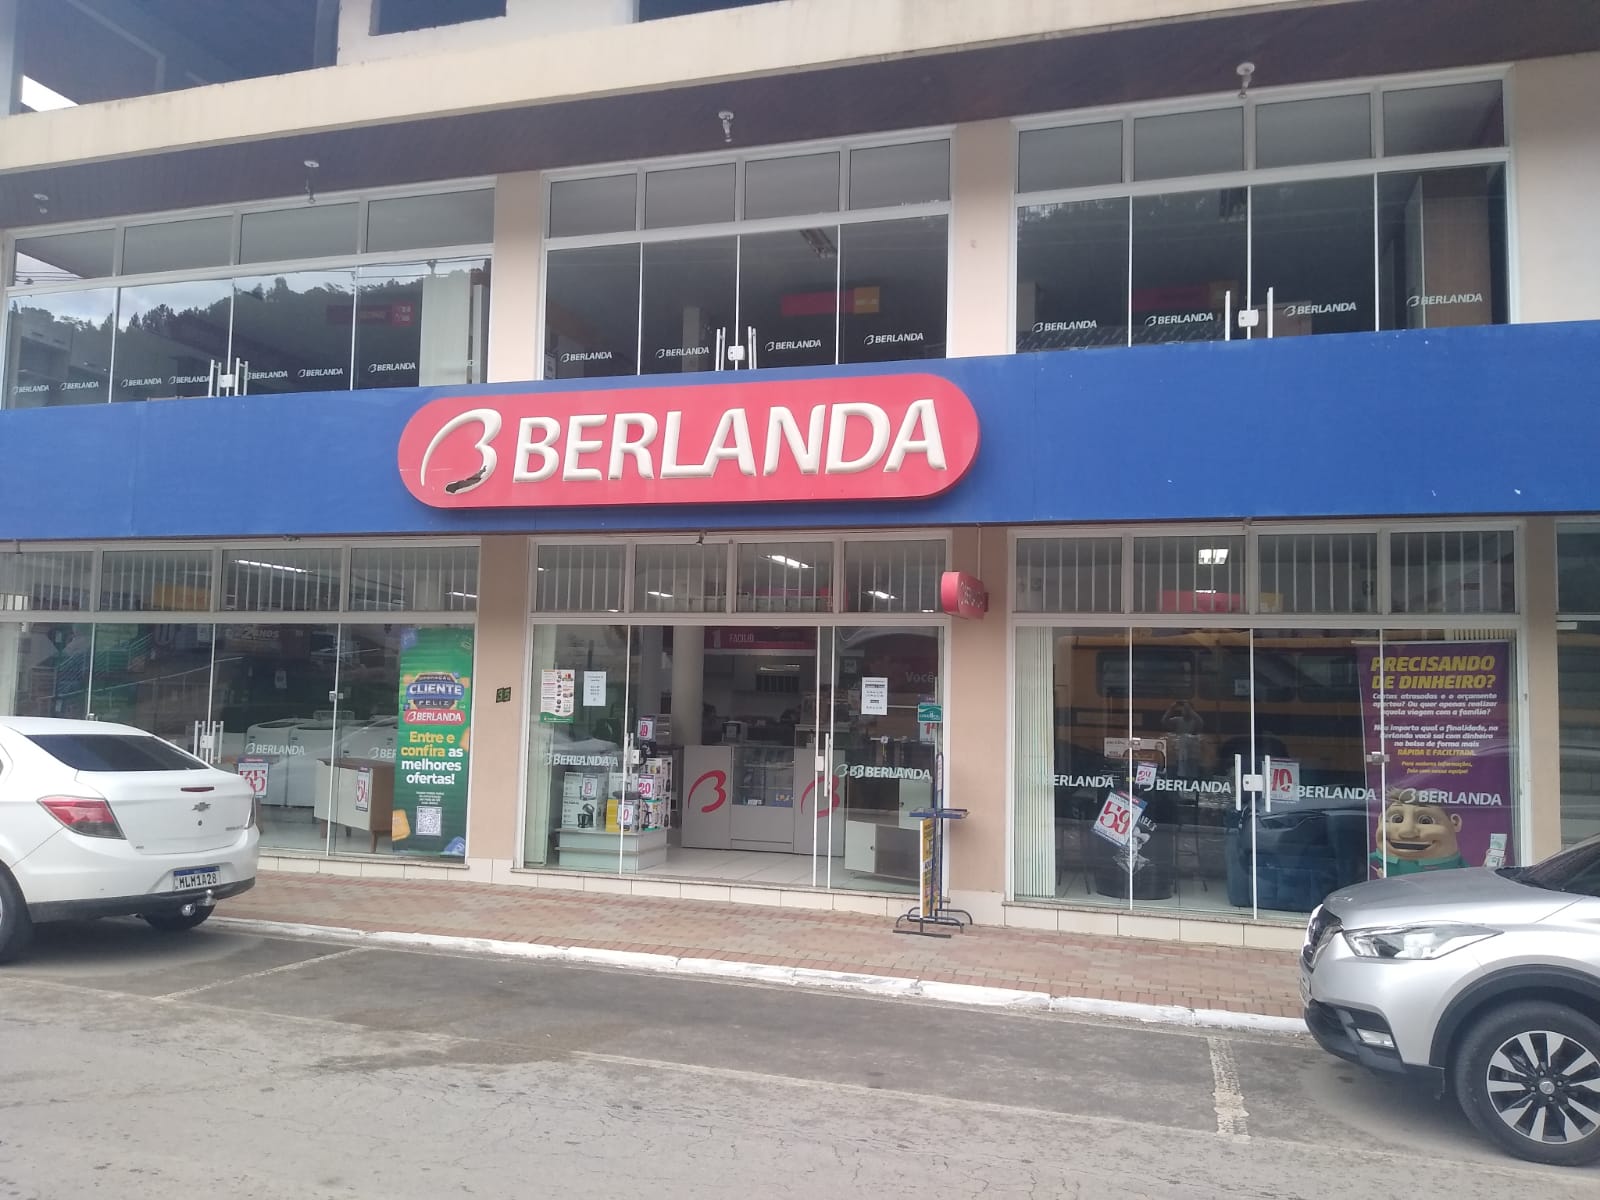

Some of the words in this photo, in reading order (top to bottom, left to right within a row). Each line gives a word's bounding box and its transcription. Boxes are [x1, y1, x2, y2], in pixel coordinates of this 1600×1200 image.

[1421, 293, 1483, 306] BERLANDA
[1297, 302, 1357, 315] BERLANDA
[1158, 312, 1214, 325] BERLANDA
[1044, 320, 1098, 332] BERLANDA
[875, 332, 924, 344] BERLANDA
[774, 339, 822, 351] BERLANDA
[569, 351, 613, 361] BERLANDA
[665, 346, 710, 358] BERLANDA
[305, 368, 344, 377] BERLANDA
[377, 362, 416, 372] BERLANDA
[251, 370, 288, 380] BERLANDA
[66, 381, 99, 390] BERLANDA
[127, 377, 162, 387] BERLANDA
[18, 384, 50, 393] BERLANDA
[512, 399, 948, 483] BERLANDA
[1370, 655, 1496, 672] PRECISANDO
[1371, 675, 1394, 689] DE
[1398, 674, 1497, 689] DINHEIRO?
[409, 683, 462, 695] CLIENTE
[1400, 692, 1438, 700] atrasadas
[1456, 693, 1498, 701] orçamento
[416, 712, 462, 722] BERLANDA
[1407, 708, 1434, 717] viagem
[1390, 724, 1419, 732] importa
[1420, 724, 1438, 732] qual
[409, 731, 444, 743] Entre
[446, 734, 455, 743] e
[256, 744, 305, 755] BERLANDA
[1436, 740, 1460, 748] forma
[401, 744, 446, 757] confira
[447, 747, 464, 757] as
[401, 758, 462, 772] melhores
[406, 772, 455, 785] ofertas!
[1049, 775, 1114, 788] ERLANDA
[1156, 779, 1231, 793] BERLANDA
[1296, 785, 1376, 800] BERLANDA
[1418, 790, 1502, 806] BERLANDA
[1100, 800, 1133, 835] 59
[179, 873, 217, 889] MLM1A28
